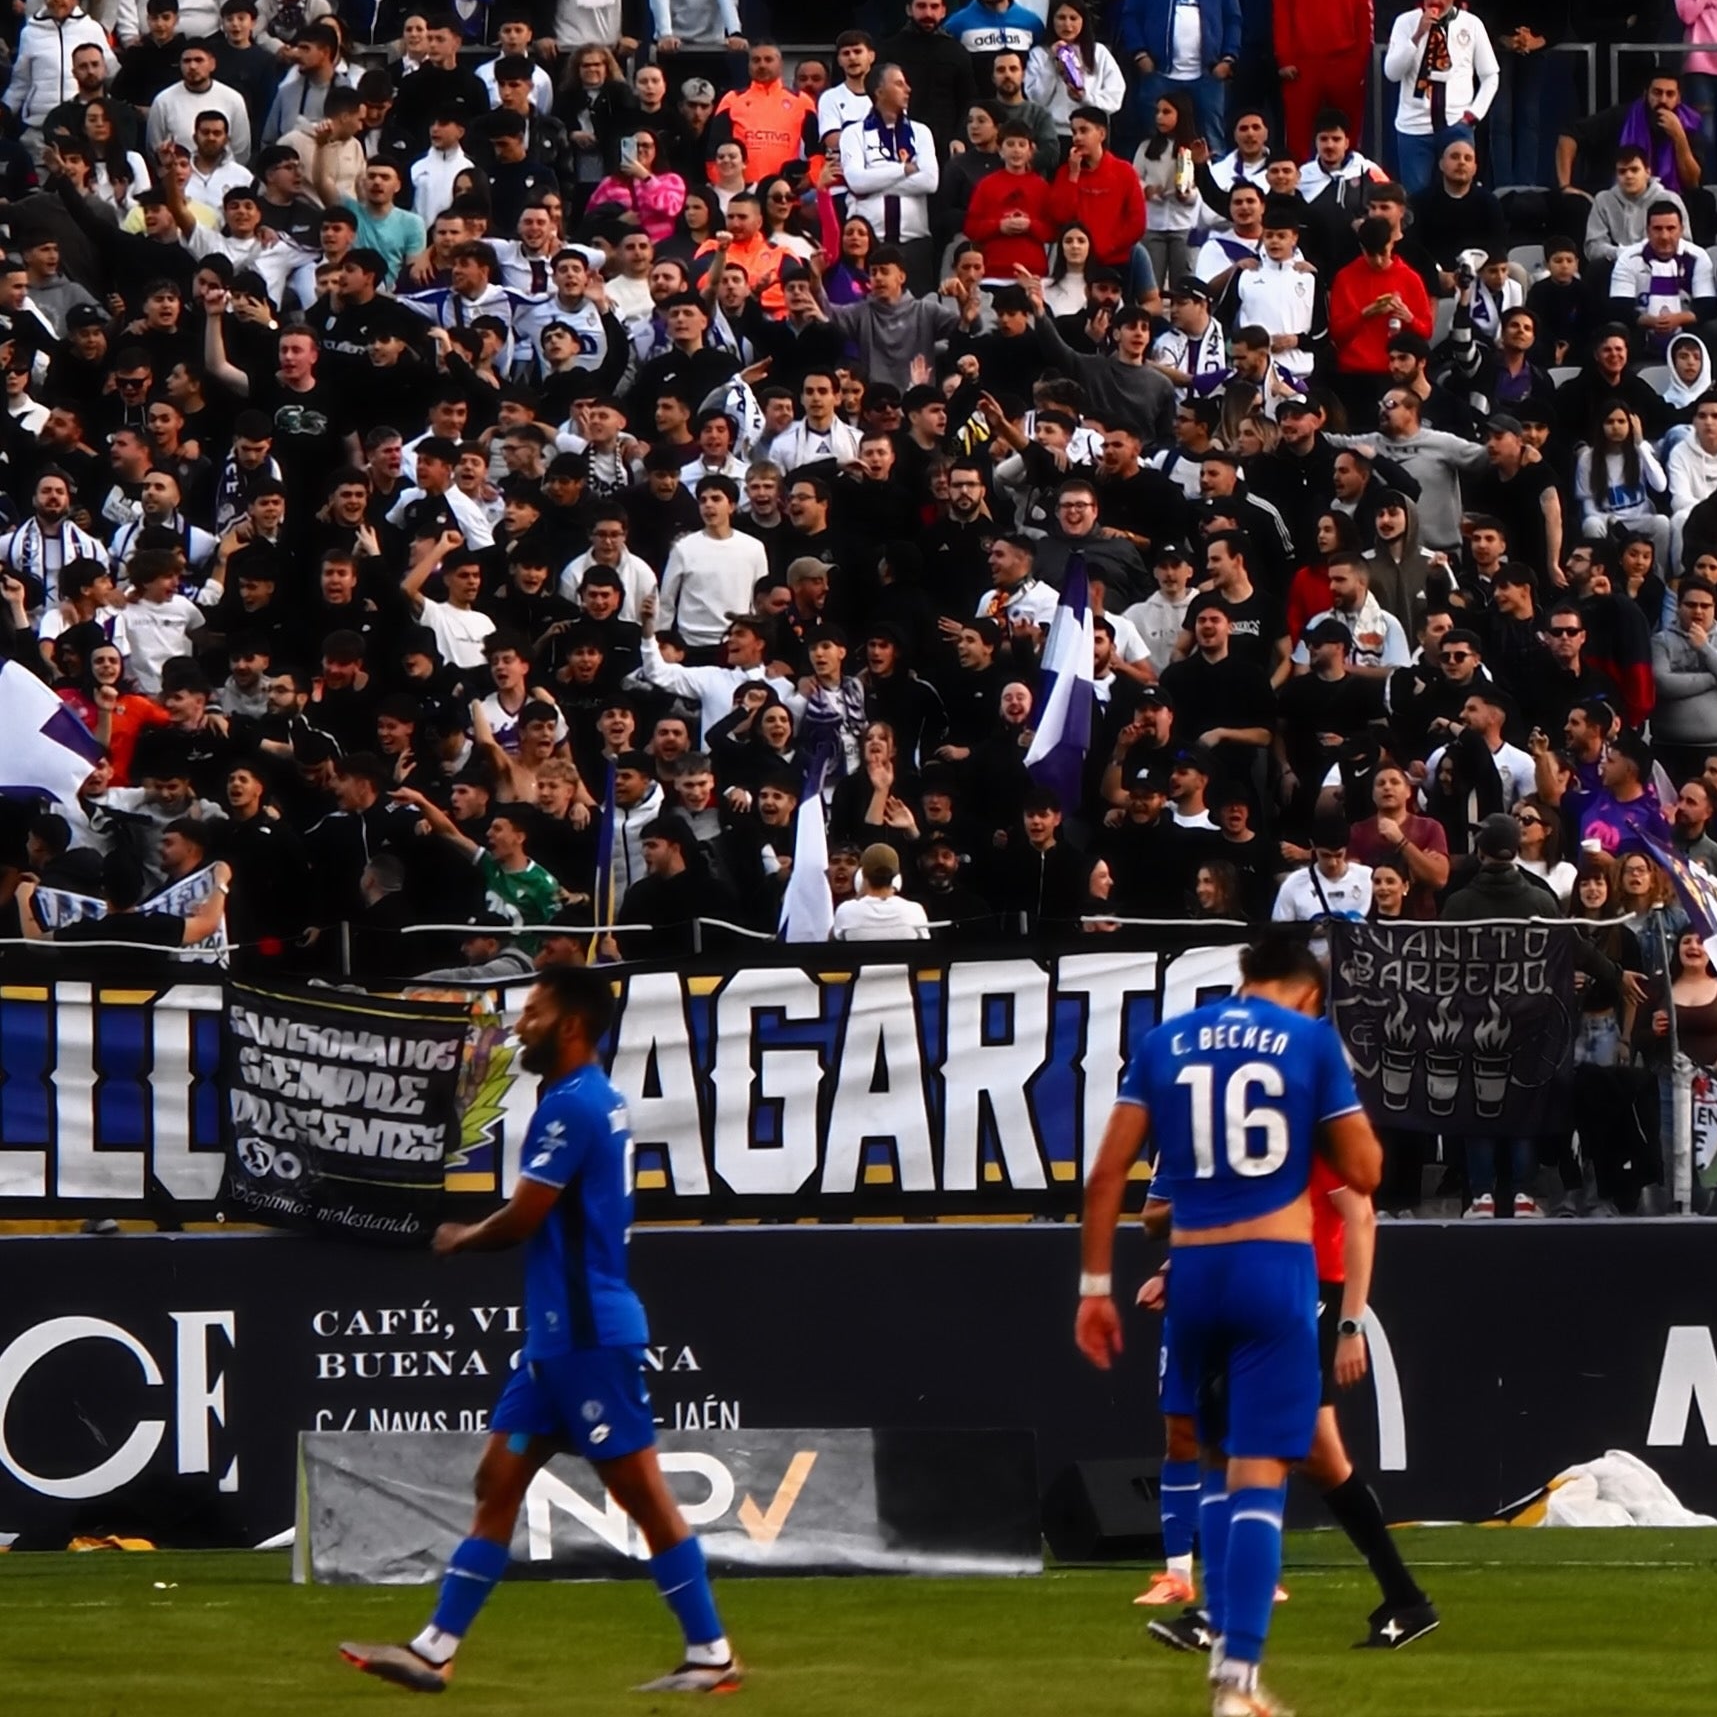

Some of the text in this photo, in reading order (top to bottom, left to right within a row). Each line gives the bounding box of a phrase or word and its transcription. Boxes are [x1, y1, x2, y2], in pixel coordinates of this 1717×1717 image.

[1175, 1061, 1290, 1179] 16
[313, 1300, 455, 1340] CAFÉ,
[317, 1350, 490, 1380] BUENA
